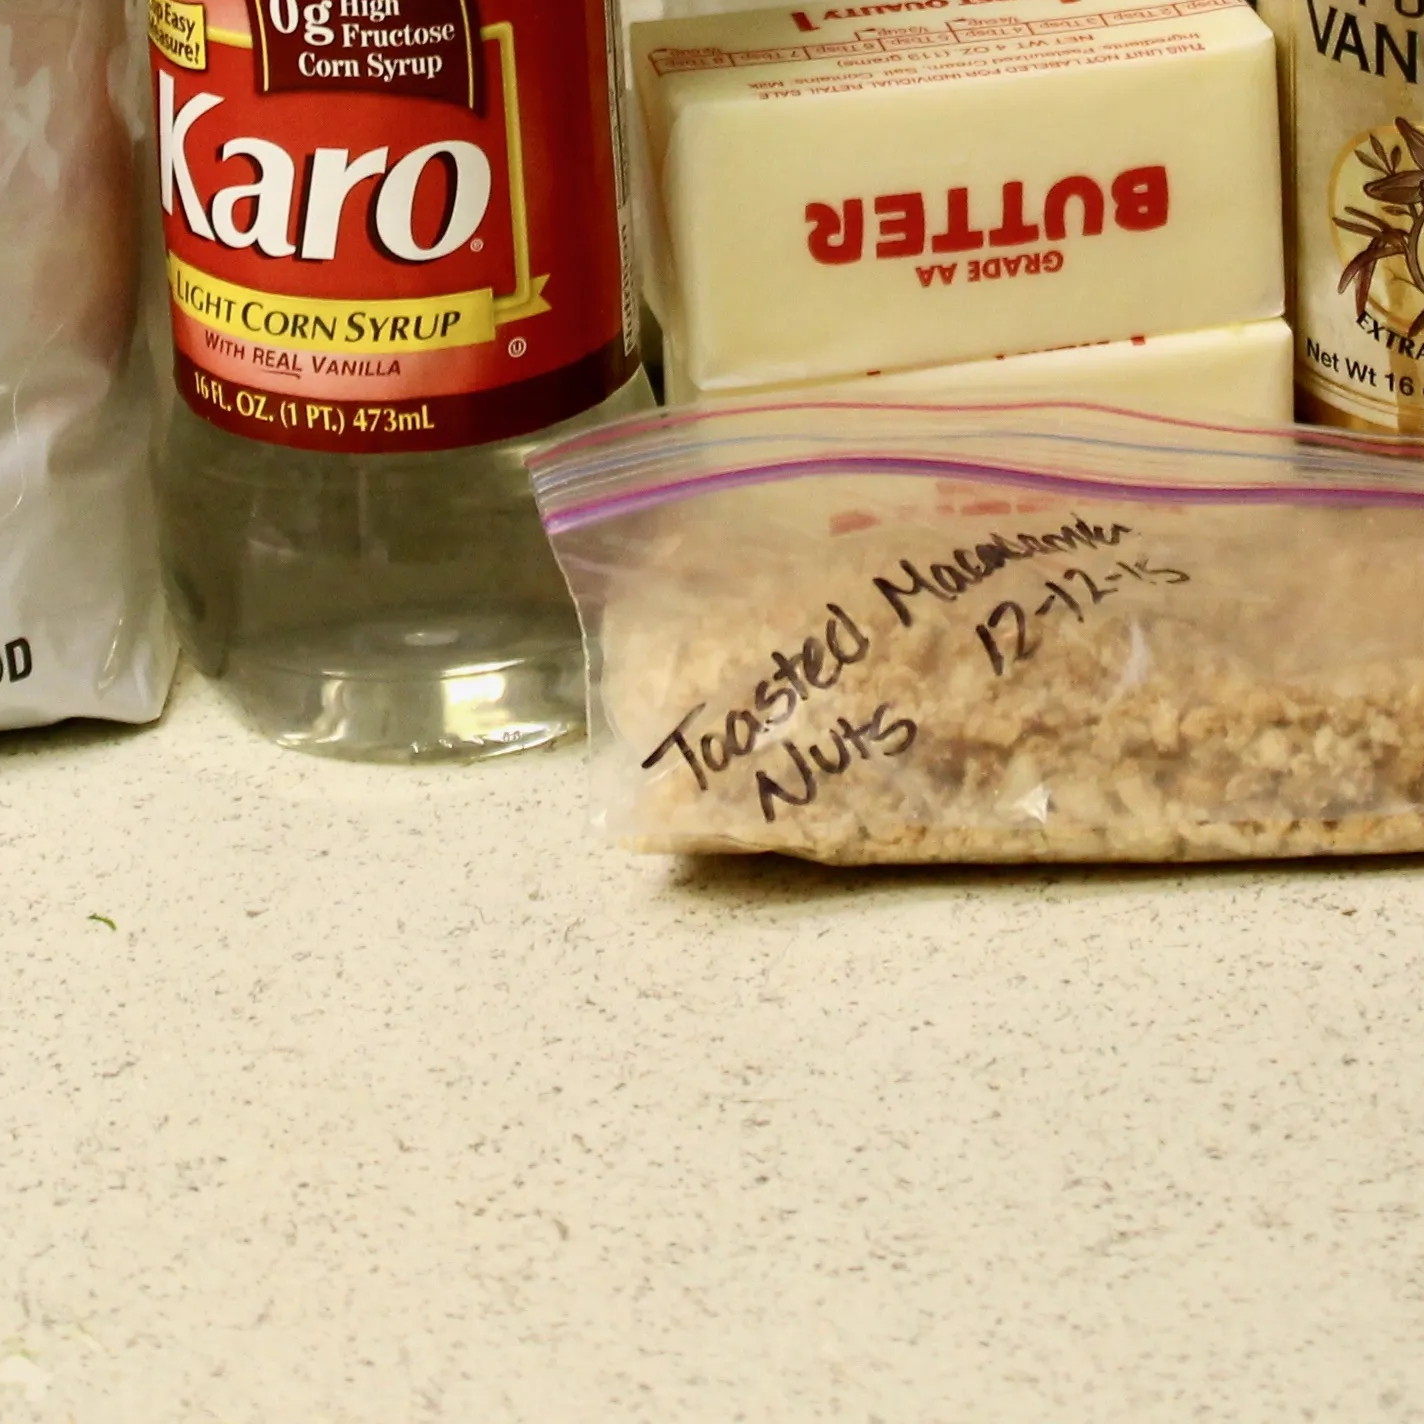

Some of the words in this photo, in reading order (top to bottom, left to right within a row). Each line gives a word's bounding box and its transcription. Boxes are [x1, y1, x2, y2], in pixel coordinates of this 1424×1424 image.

[165, 2, 196, 41] Easy
[341, 19, 456, 49] Fructose
[1016, 39, 1047, 49] WT
[1054, 34, 1095, 45] NET
[1123, 47, 1163, 60] UNIT
[1168, 43, 1206, 55] THIS
[298, 51, 360, 78] Corn
[366, 54, 443, 82] Syrup
[965, 67, 1002, 79] FOR
[1005, 58, 1082, 74] LABELED
[1086, 53, 1120, 65] NOT
[757, 89, 802, 101] SALE
[809, 82, 864, 94] RETAIL
[872, 72, 962, 89] INDIVIDUAL
[158, 69, 491, 262] Karo
[805, 164, 1168, 266] BUTTER
[915, 262, 958, 289] AA
[968, 249, 1065, 283] GRADE
[176, 270, 238, 324] LIGHT
[241, 301, 336, 342] CORN
[344, 309, 462, 343] SYRUP
[204, 329, 245, 362] WITH
[252, 346, 303, 372] REAL
[312, 355, 401, 377] VANILLA
[1307, 338, 1339, 373] Net
[1345, 360, 1377, 388] Wt
[1384, 372, 1414, 398] 16
[194, 371, 210, 399] 16
[210, 379, 232, 412] FL.
[236, 391, 274, 423] OZ.
[279, 400, 298, 428] (1
[307, 405, 346, 434] PT.)
[353, 405, 435, 433] 473mL
[641, 602, 871, 791] Toasted
[754, 702, 918, 823] Nuts
